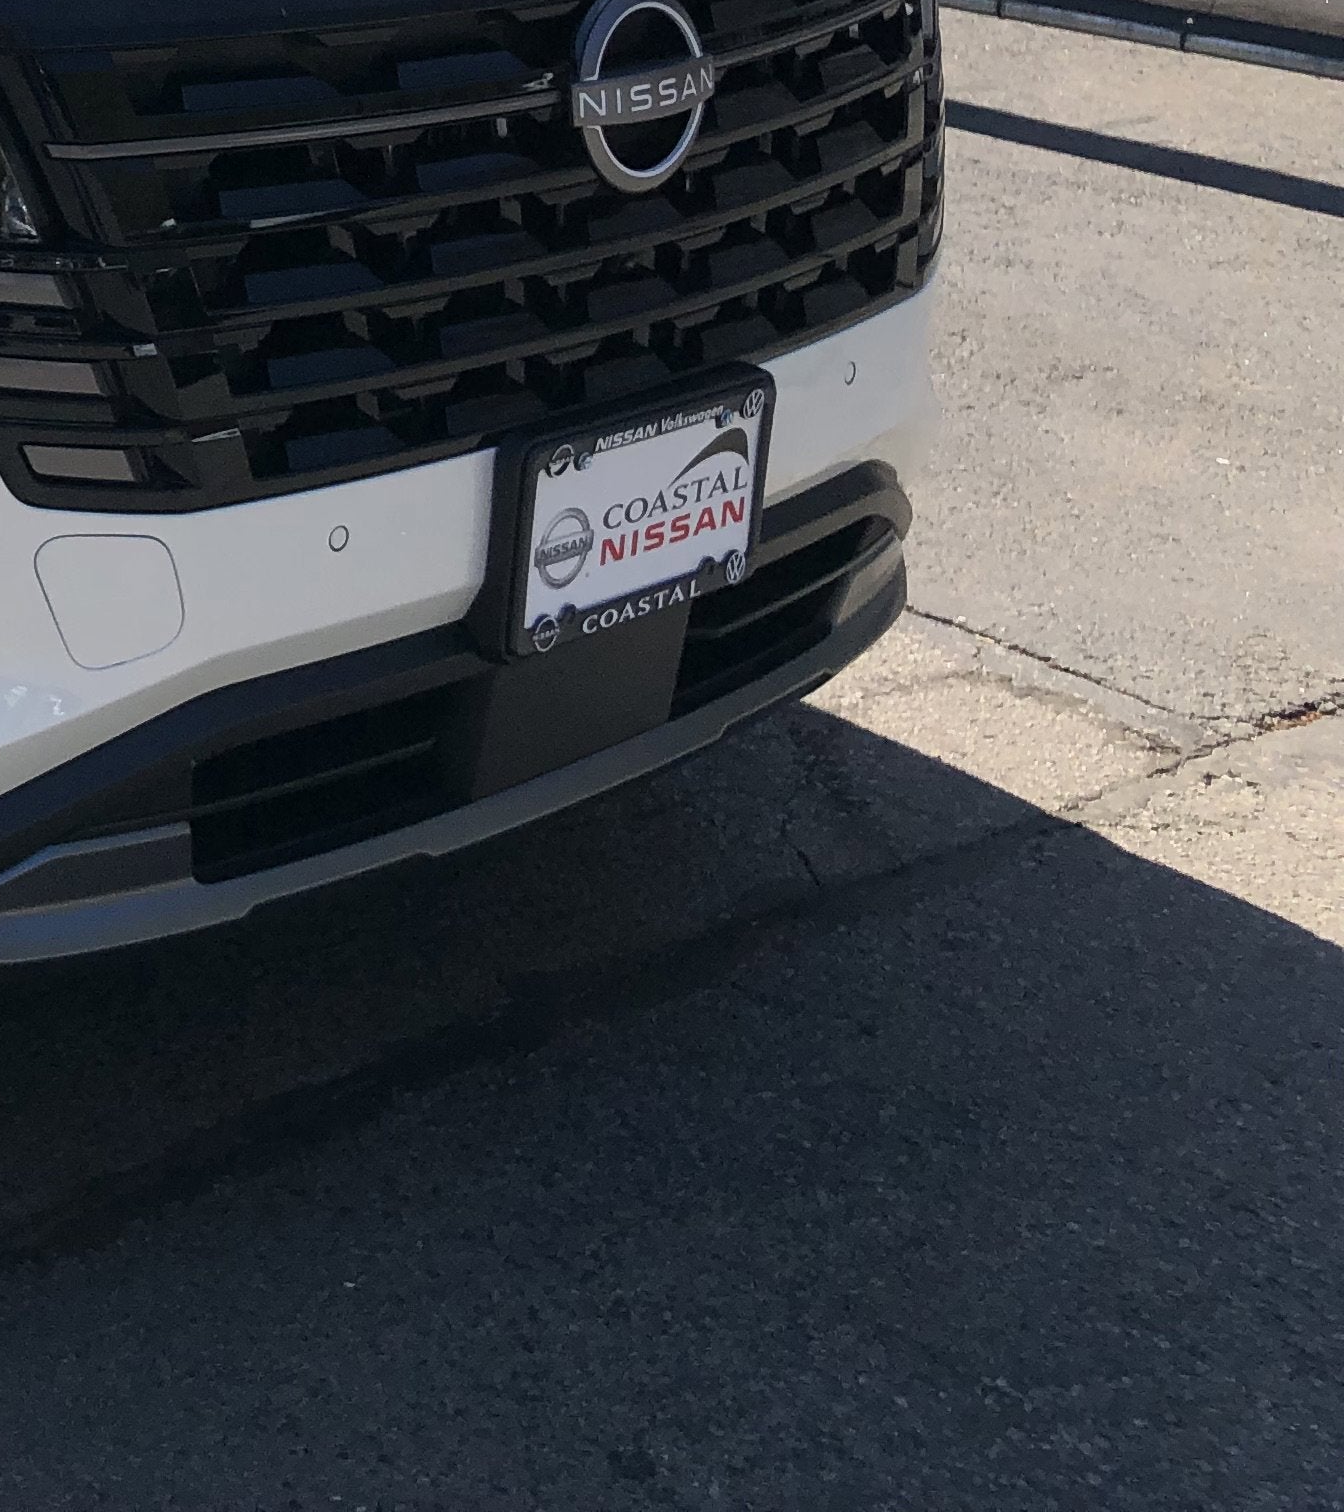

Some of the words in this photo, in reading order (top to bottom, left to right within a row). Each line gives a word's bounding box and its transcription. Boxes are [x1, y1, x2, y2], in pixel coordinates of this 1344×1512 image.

[578, 63, 714, 119] NISSAN
[594, 422, 658, 452] NISSAN
[602, 465, 749, 530] COASTAL
[539, 535, 589, 560] NISSAN
[598, 496, 746, 567] NISSAN
[581, 578, 702, 635] COASTAL
